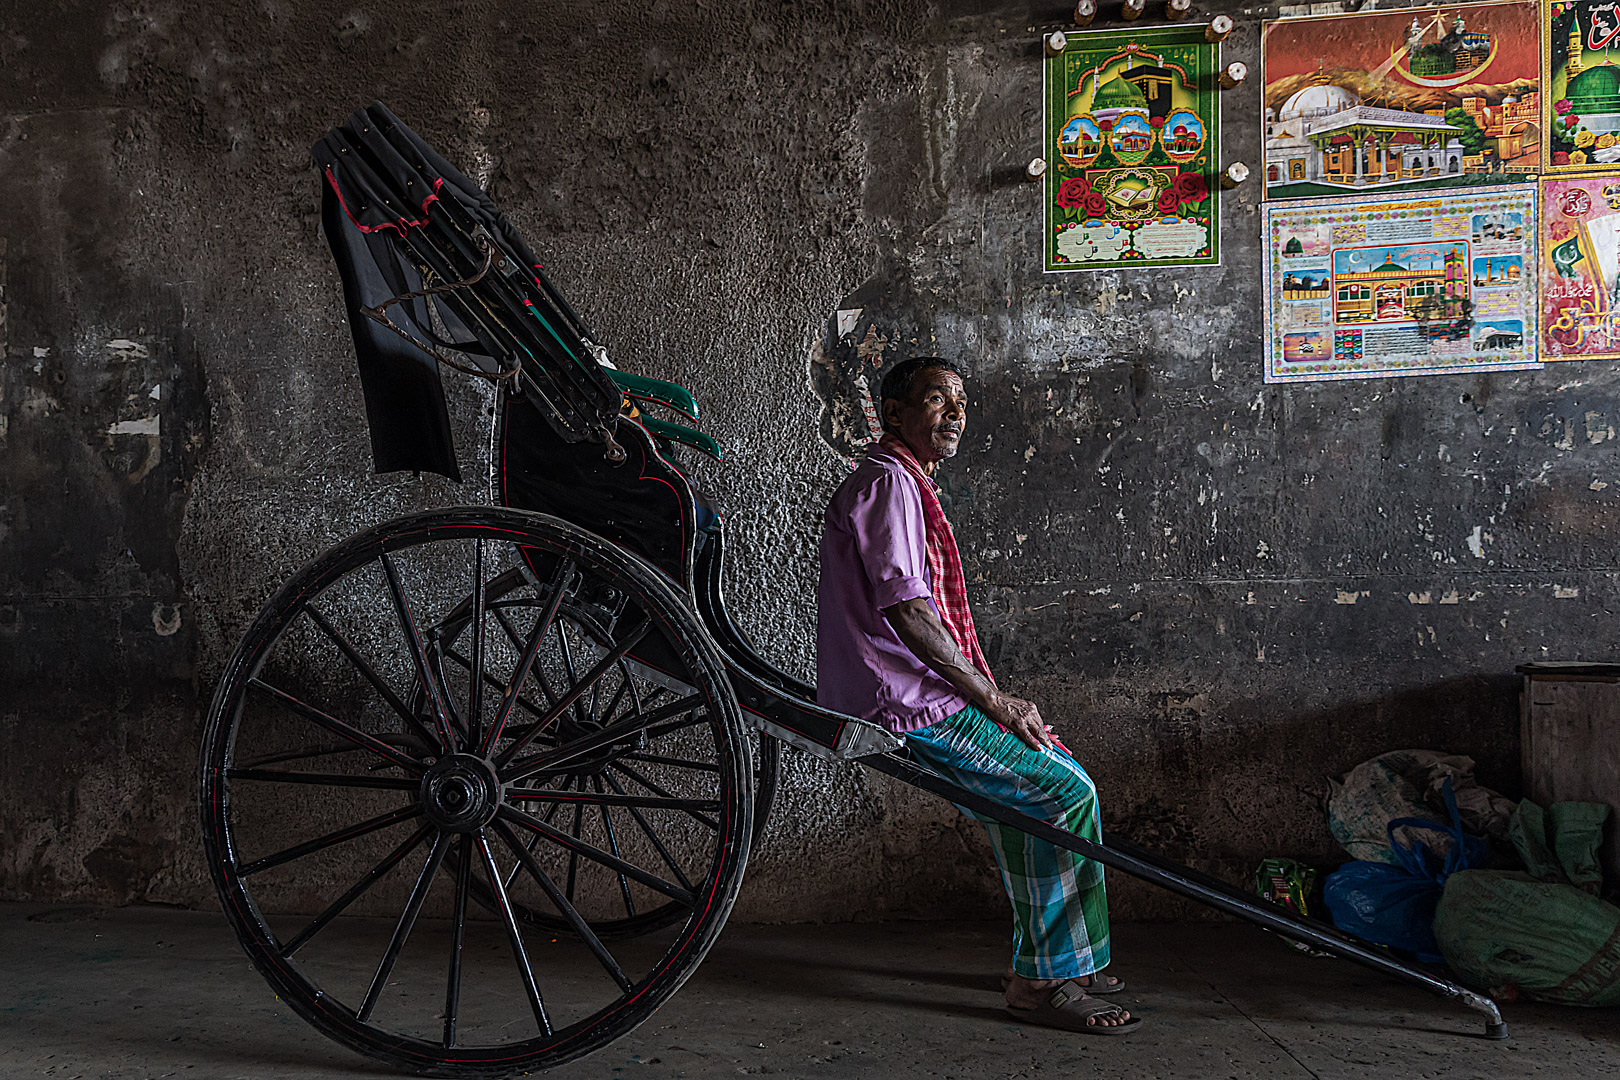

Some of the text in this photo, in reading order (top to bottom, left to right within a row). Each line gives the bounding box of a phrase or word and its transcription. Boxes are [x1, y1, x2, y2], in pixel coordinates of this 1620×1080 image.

[1075, 233, 1090, 246] قل
[1105, 227, 1121, 240] قل
[1114, 239, 1129, 252] قل
[1083, 246, 1099, 259] قل
